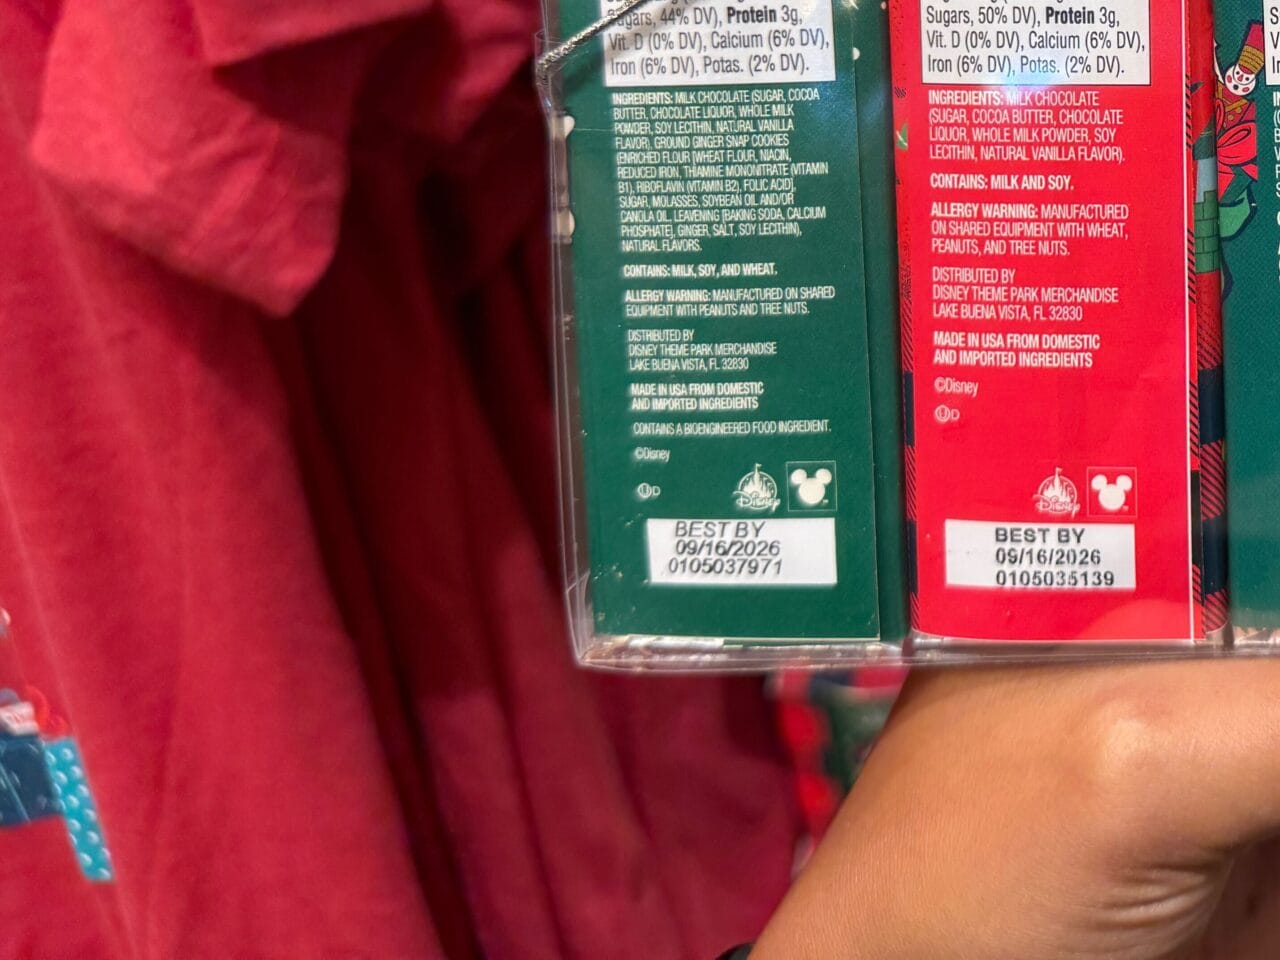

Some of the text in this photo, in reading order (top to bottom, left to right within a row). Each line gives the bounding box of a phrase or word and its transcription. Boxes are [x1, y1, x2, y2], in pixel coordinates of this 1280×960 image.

[930, 173, 1074, 190] CONTAINS: MILK AND SOY.
[623, 262, 778, 278] CONTAINS: MILK, SOY, AND WHEAT.
[933, 331, 1101, 350] MADE IN USA FROM DOMESTIC
[933, 350, 1093, 367] AND IMPORTED INGREDIENTS
[675, 520, 766, 538] BEST BY
[995, 527, 1086, 543] BEST BY
[675, 540, 780, 557] 09/16/2026
[668, 558, 783, 575] 0105037971
